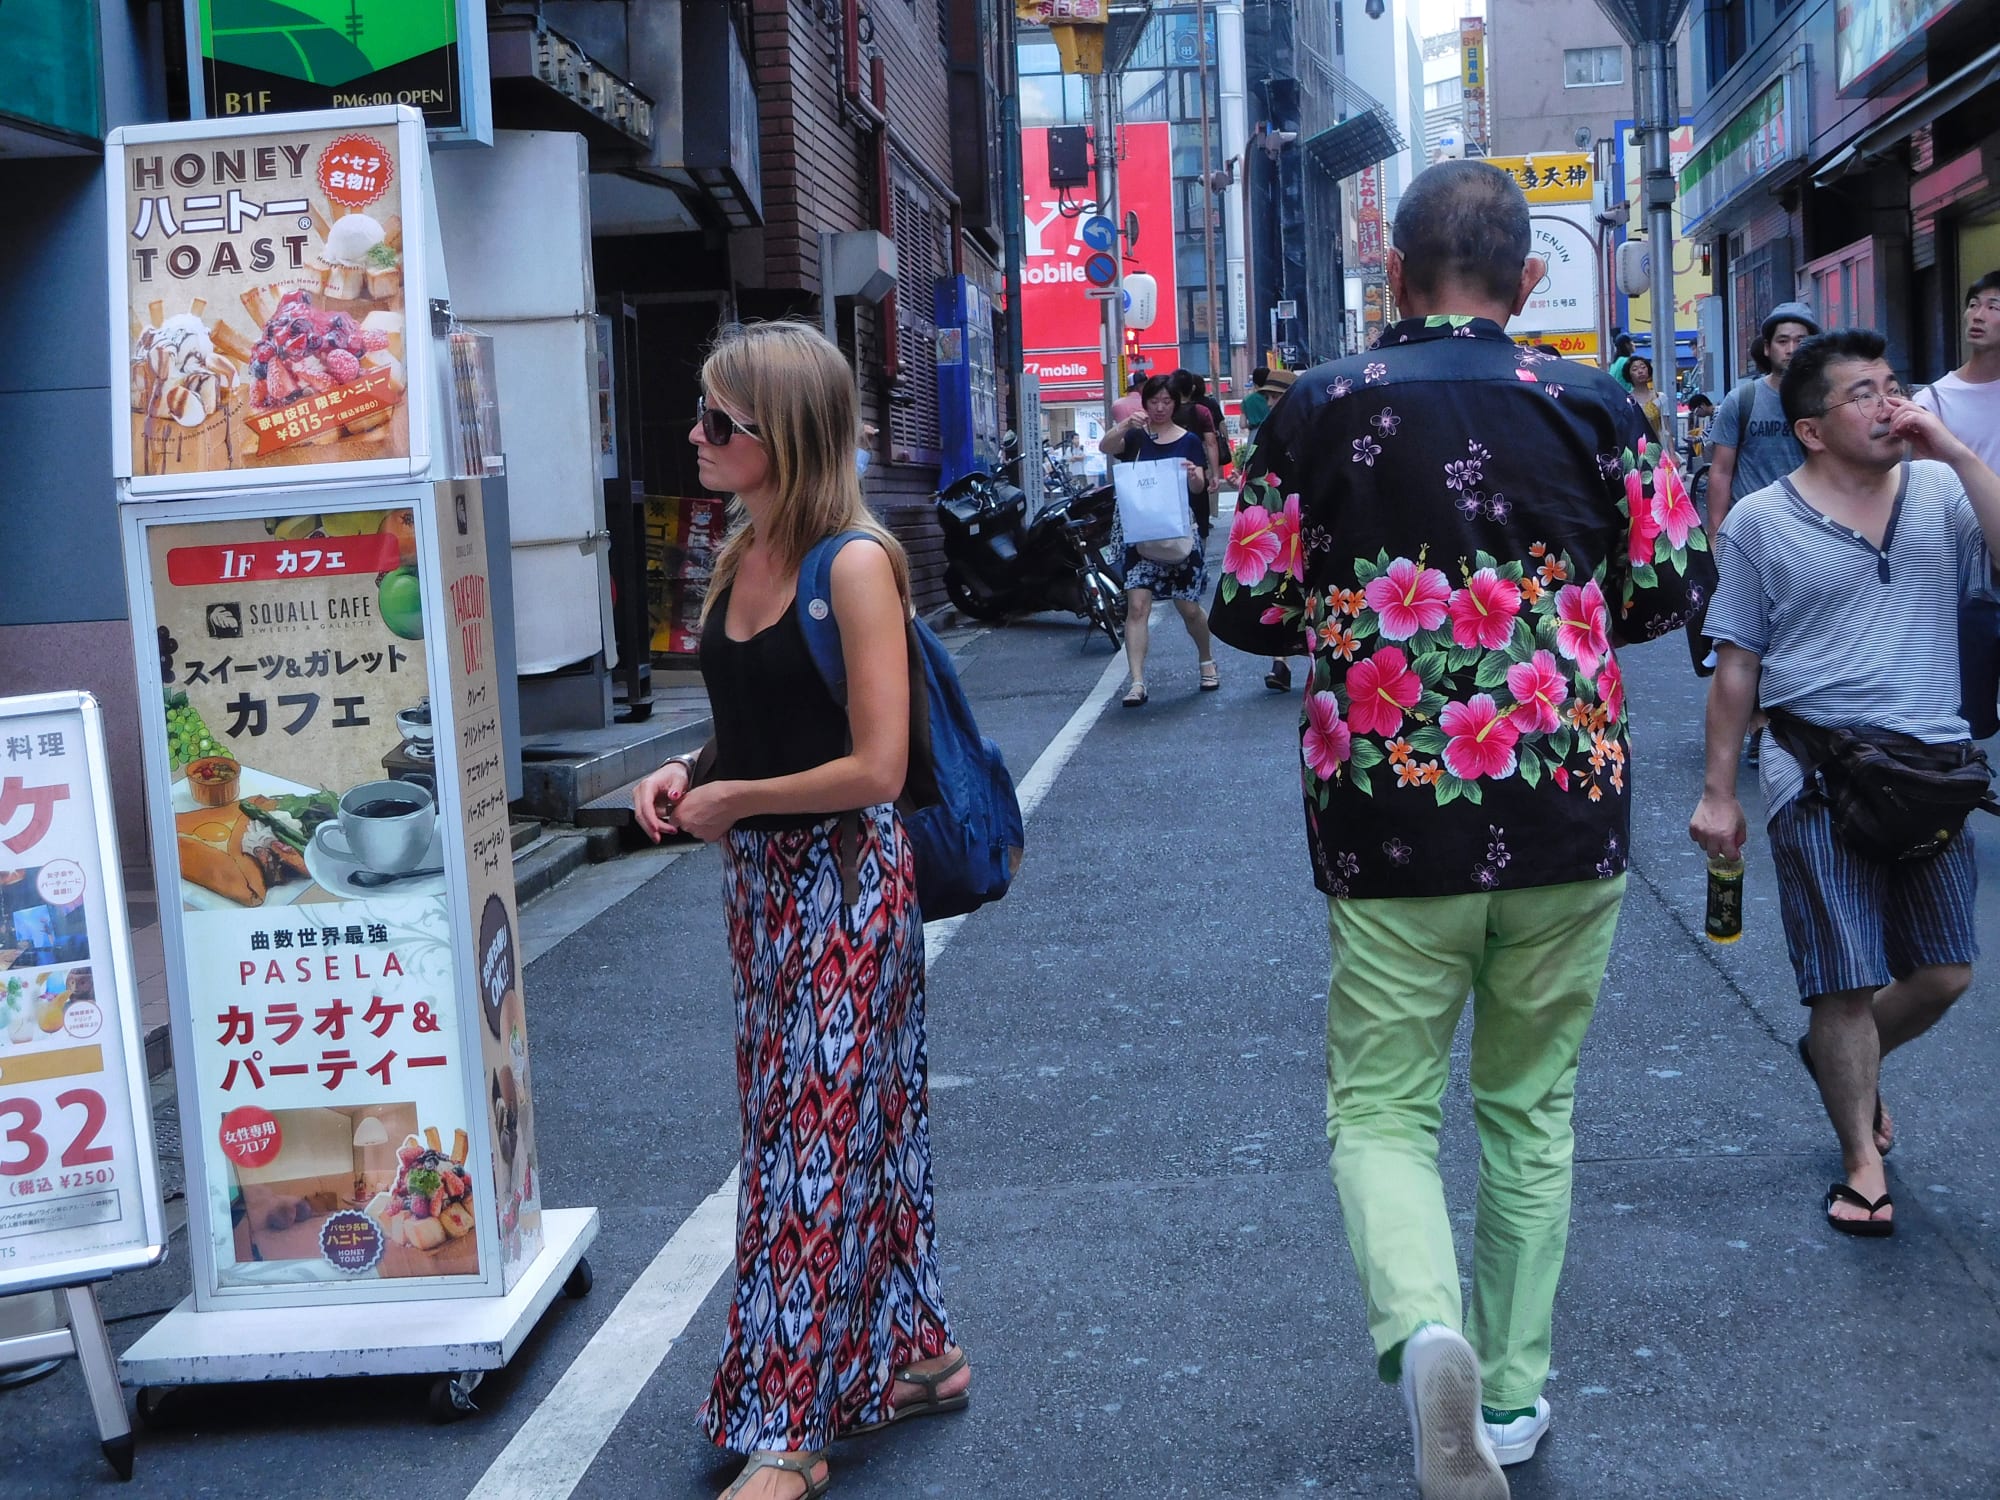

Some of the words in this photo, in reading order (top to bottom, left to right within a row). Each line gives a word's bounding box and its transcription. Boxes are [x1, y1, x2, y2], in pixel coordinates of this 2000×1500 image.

[225, 91, 272, 115] B1F
[333, 91, 393, 108] PM6:00
[396, 89, 444, 106] OPEN
[133, 143, 311, 191] HONEY
[331, 152, 381, 175] パセラ
[1505, 165, 1587, 190] 多天神
[329, 171, 376, 192] 名物!!
[132, 235, 309, 282] TOAST
[1535, 230, 1571, 263] TENJIN
[297, 278, 320, 287] Honey
[1040, 363, 1088, 377] mobile
[258, 402, 310, 431] 歌舞伎町
[315, 376, 387, 410] 限定ハニトー
[219, 550, 256, 579] 1F
[276, 549, 347, 574] カフェ
[250, 600, 319, 625] SQUALL
[328, 596, 371, 620] CAFE
[450, 573, 485, 627] TAKEOUT
[320, 620, 373, 630] GALETTE
[462, 622, 484, 676] OK!!
[184, 644, 407, 686] スイーツ&ガレット
[225, 691, 371, 739] カフェ
[0, 731, 66, 762] 料理
[464, 719, 496, 749] プリントケーキ
[466, 757, 499, 787] アニマルケーキ
[473, 827, 505, 861] デコレーション
[484, 852, 499, 877] ケーキ
[251, 923, 389, 951] 曲数世界最強
[240, 951, 404, 986] PASELA
[491, 955, 509, 1008] OK!!
[216, 995, 441, 1046] カラオケ&
[219, 1049, 447, 1092] パーティー
[0, 1088, 114, 1177] 32
[223, 1121, 276, 1144] 女性専用
[235, 1137, 272, 1157] フロア
[338, 1248, 366, 1257] HONEY
[339, 1255, 365, 1263] TOAST
